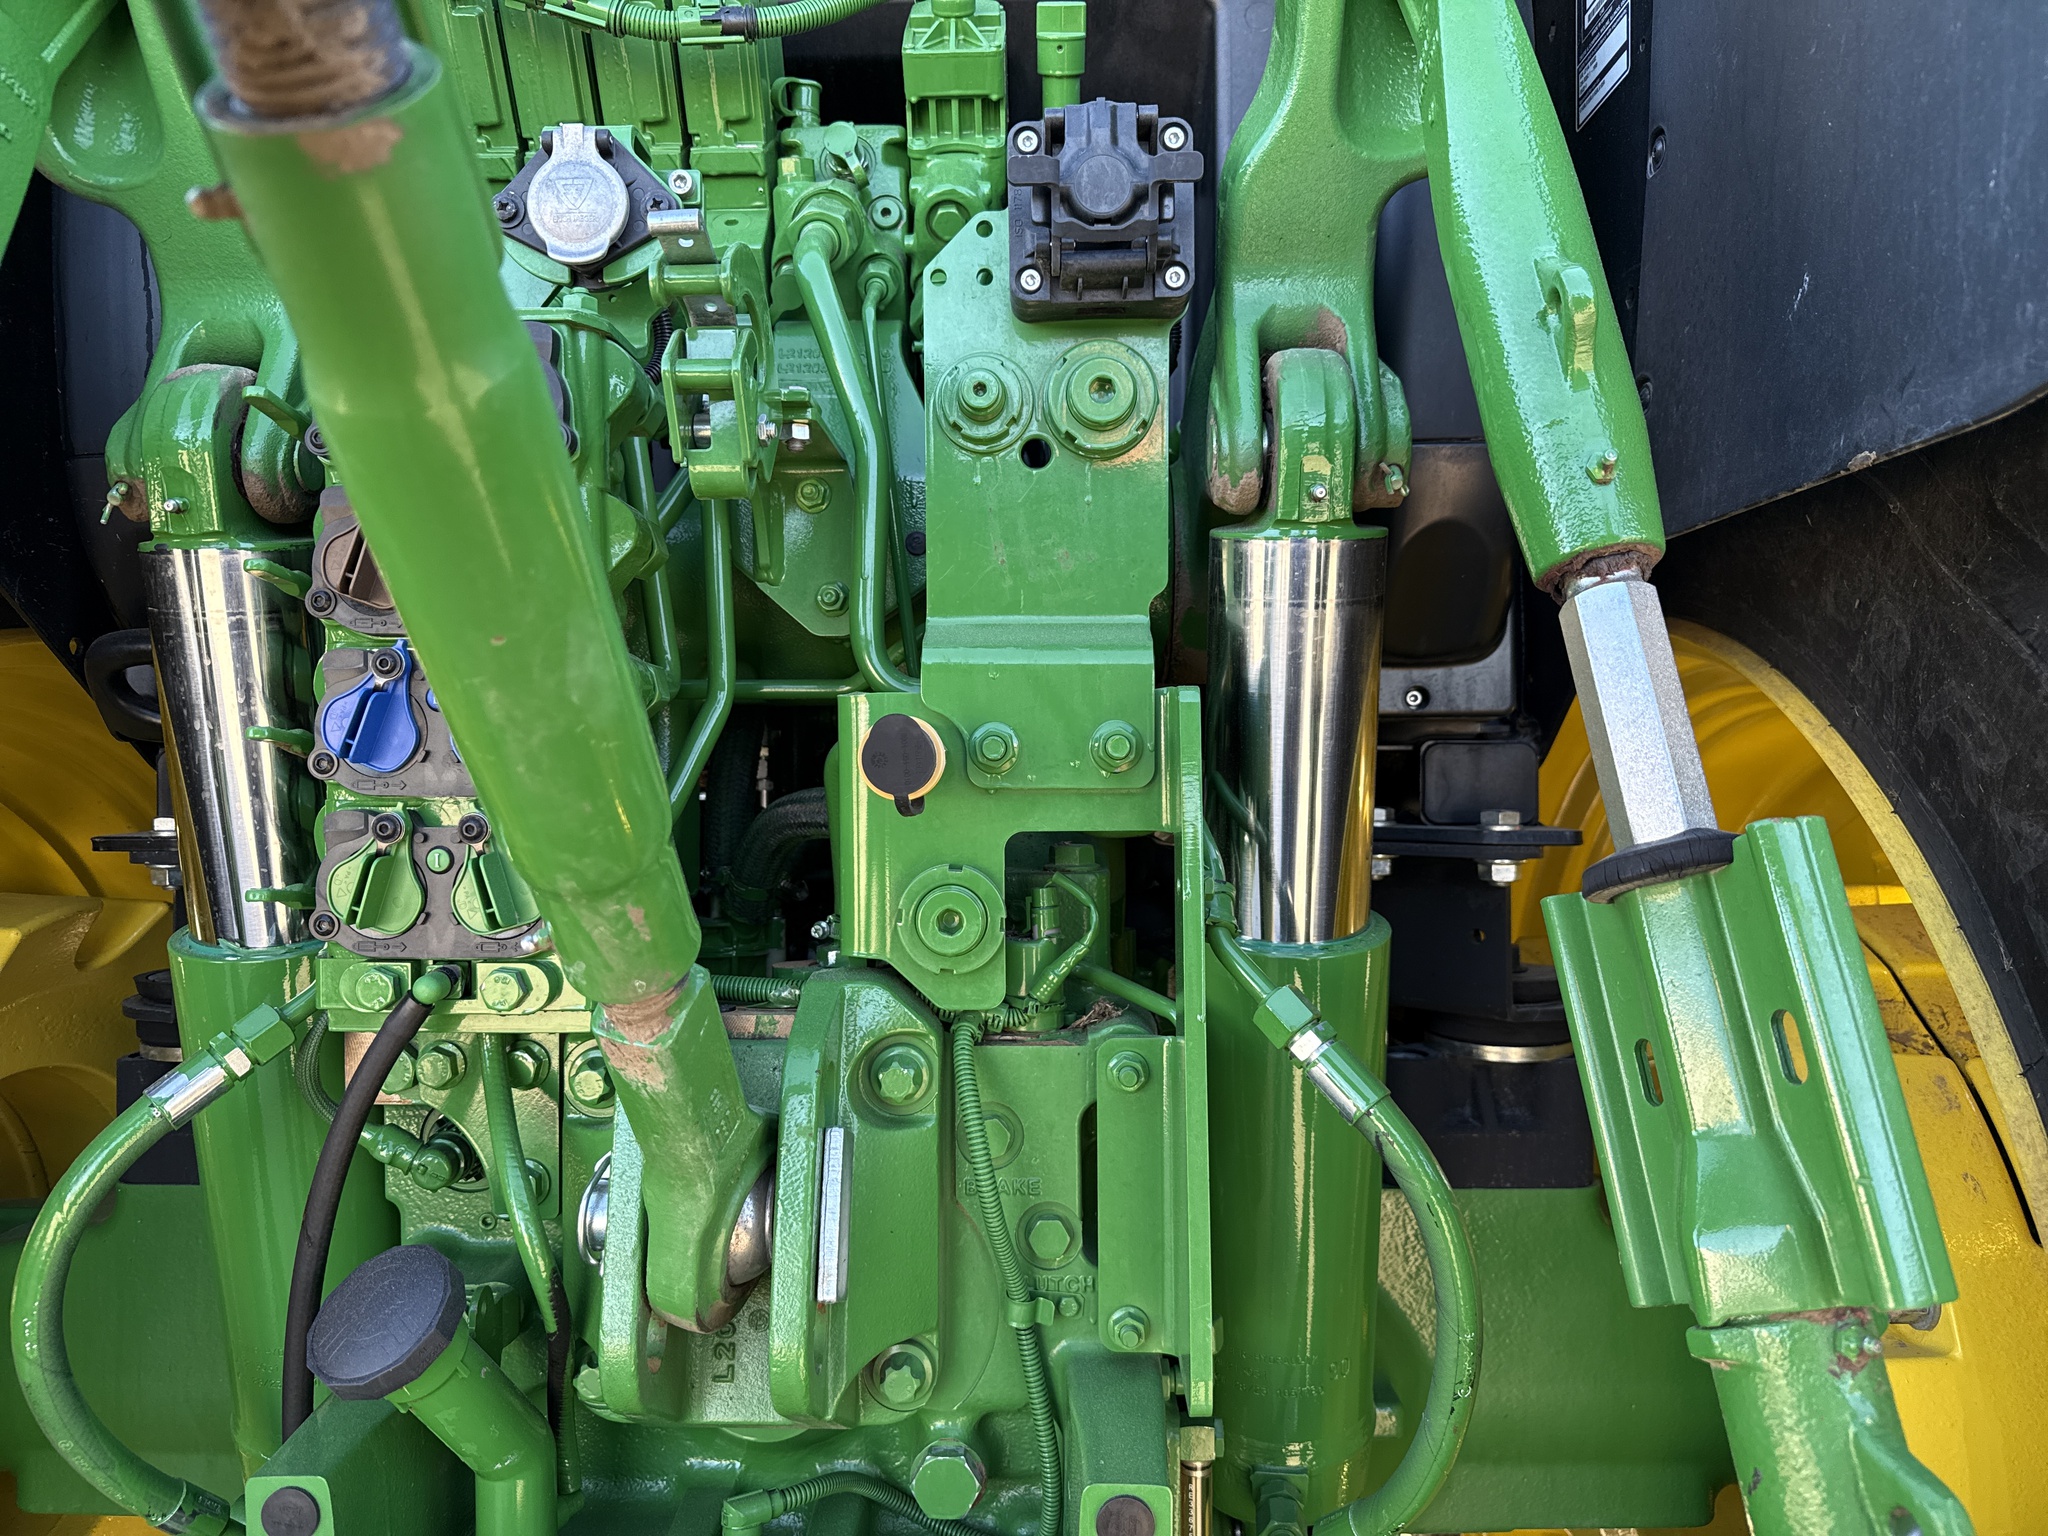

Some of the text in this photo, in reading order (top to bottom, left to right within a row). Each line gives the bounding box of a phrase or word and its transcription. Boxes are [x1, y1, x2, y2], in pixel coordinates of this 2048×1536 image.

[1014, 219, 1023, 238] ISO
[965, 1177, 1042, 1196] BAKE
[1023, 1275, 1096, 1293] LUTCH
